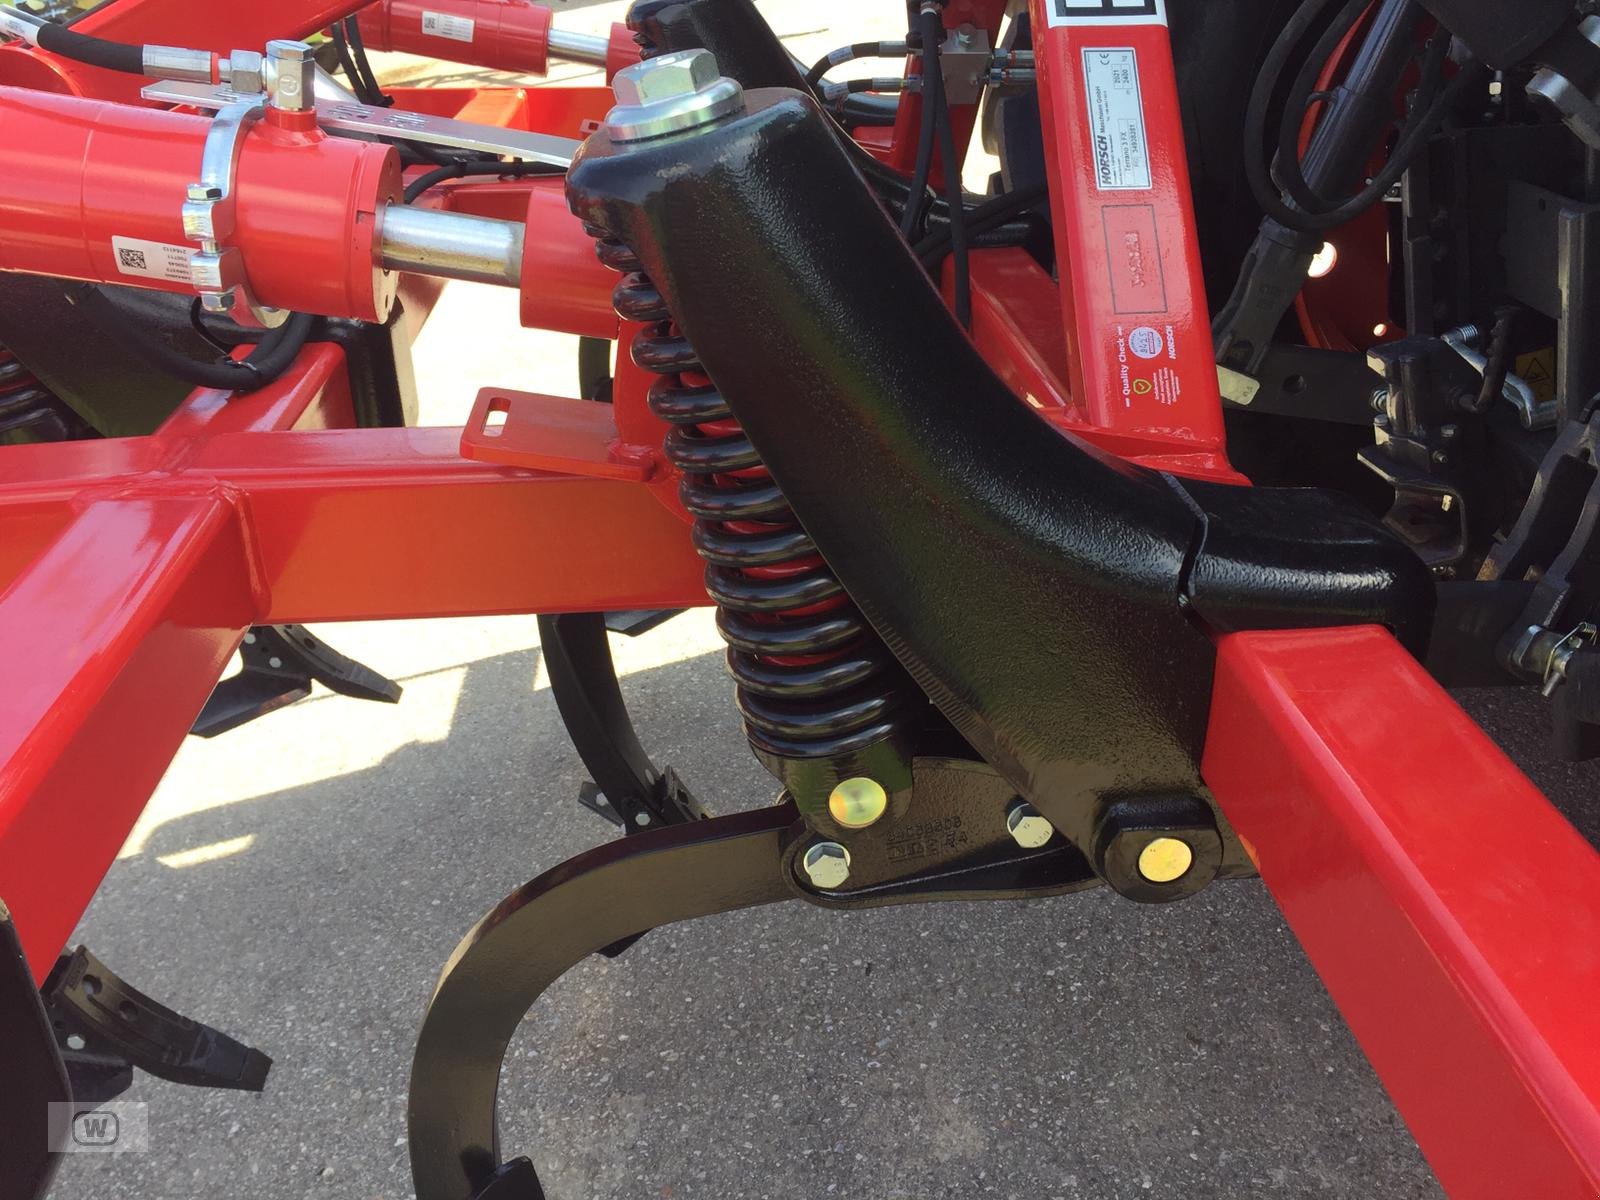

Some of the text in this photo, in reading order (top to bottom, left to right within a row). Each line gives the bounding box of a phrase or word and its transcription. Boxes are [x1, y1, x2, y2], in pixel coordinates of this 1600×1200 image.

[1095, 87, 1103, 103] GmbH
[1097, 135, 1112, 185] HORSCH
[1121, 147, 1131, 172] Terrano
[1165, 325, 1177, 360] HORSCH
[1117, 337, 1131, 396] Quality Check
